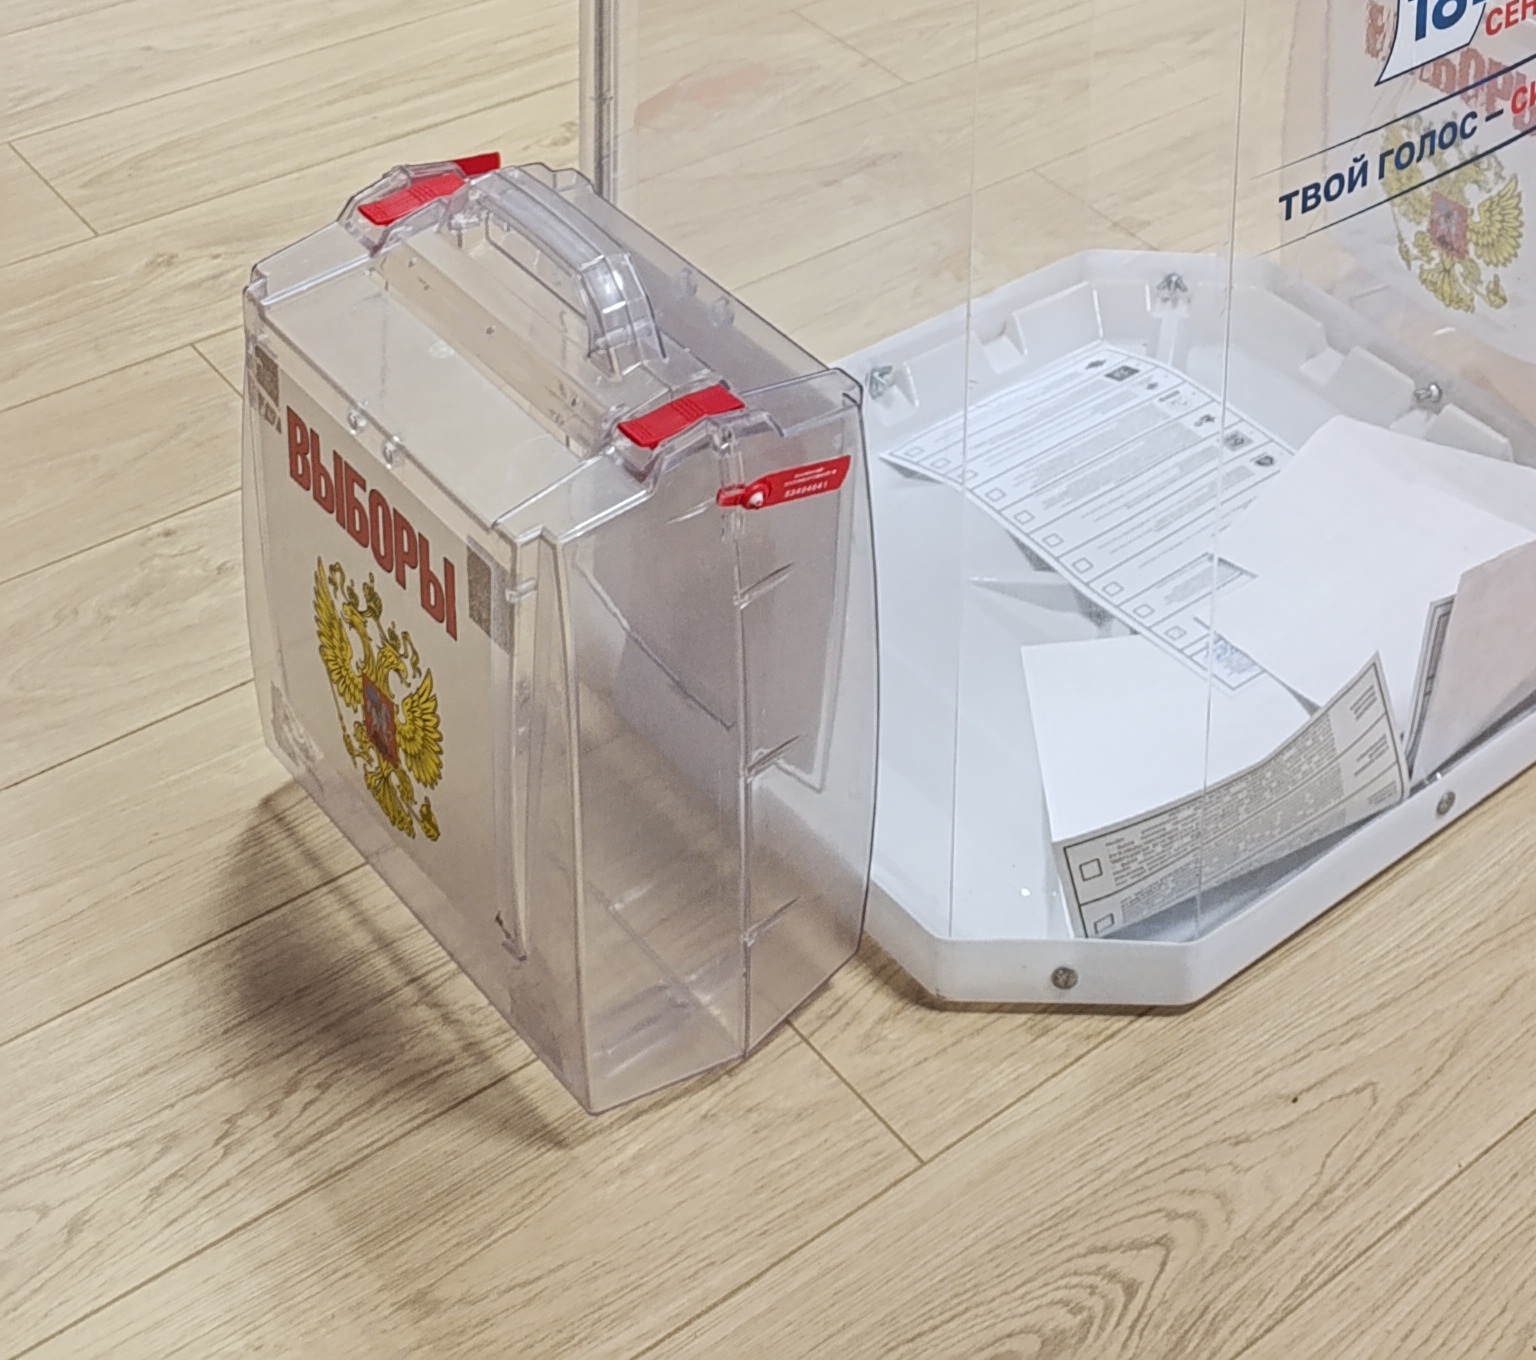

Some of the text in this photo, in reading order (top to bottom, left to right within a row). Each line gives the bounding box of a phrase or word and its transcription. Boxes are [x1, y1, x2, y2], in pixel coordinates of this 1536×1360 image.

[1279, 158, 1368, 221] ТВОЙ
[1378, 111, 1478, 180] ГОЛОС
[286, 405, 458, 642] ВЫБОРЫ
